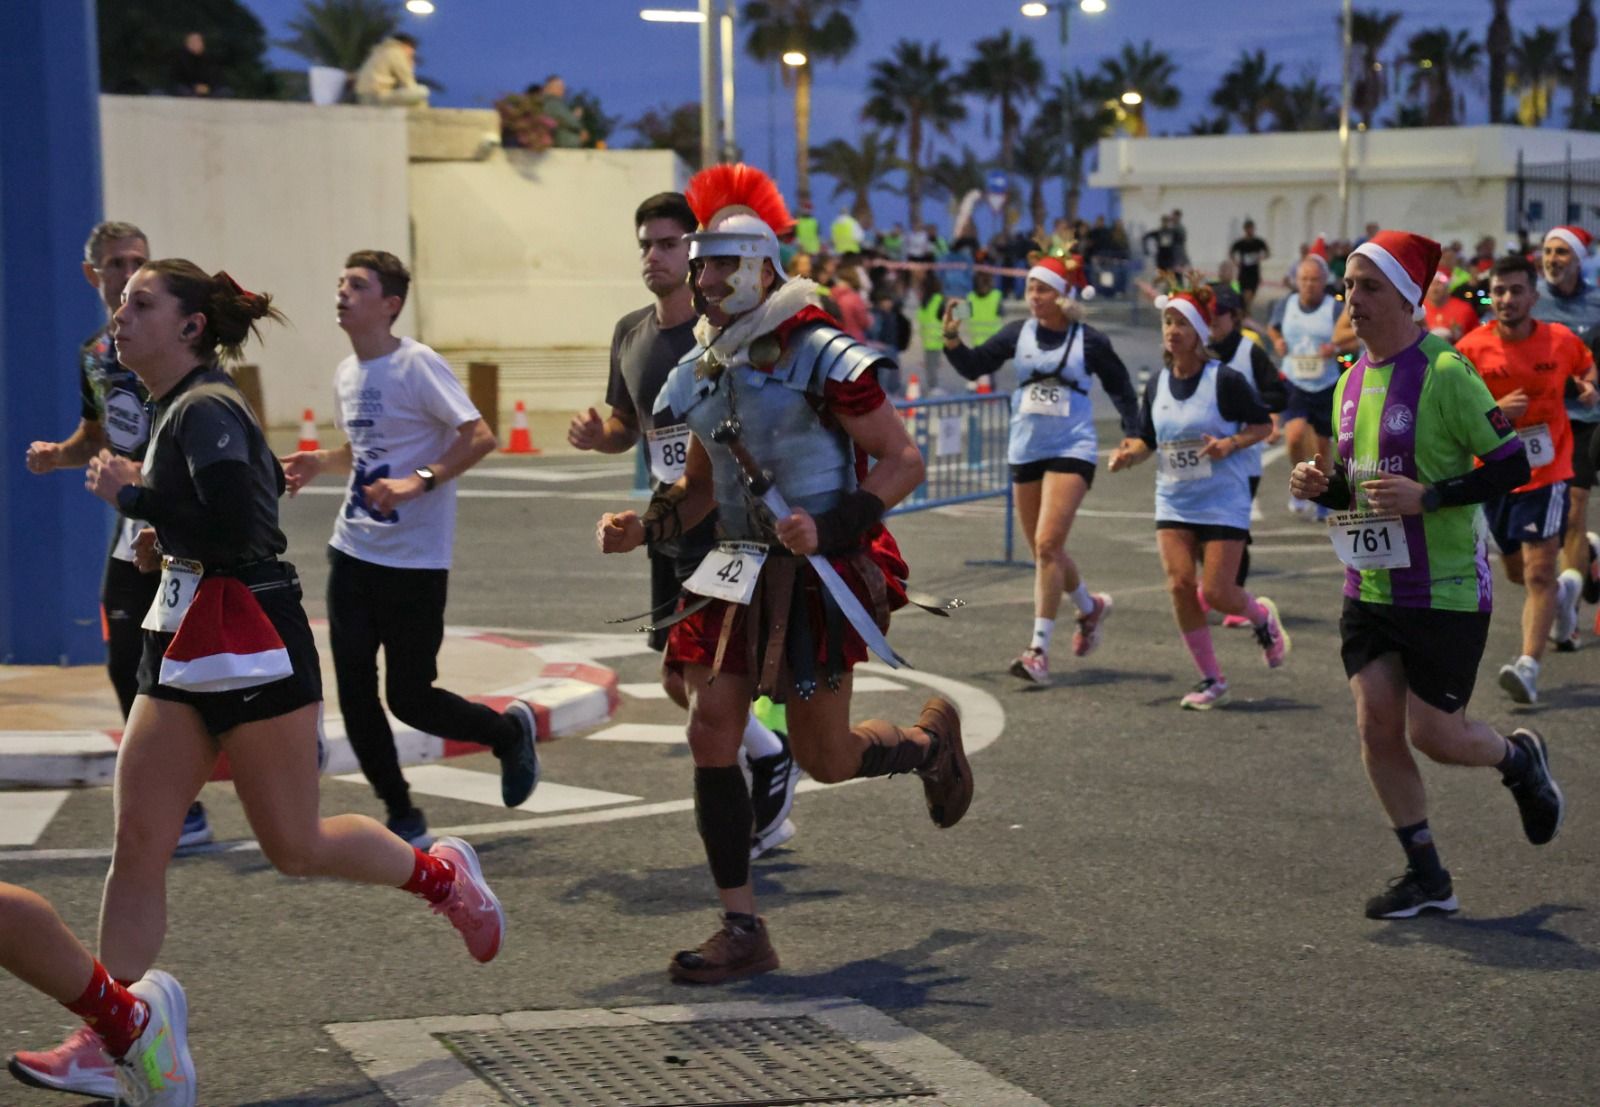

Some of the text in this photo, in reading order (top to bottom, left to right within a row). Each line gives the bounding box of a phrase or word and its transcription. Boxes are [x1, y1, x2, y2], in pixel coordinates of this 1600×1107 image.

[1031, 386, 1060, 403] 656
[662, 442, 687, 466] 88
[1169, 450, 1200, 469] 655
[1347, 526, 1392, 553] 761
[716, 559, 744, 583] 42
